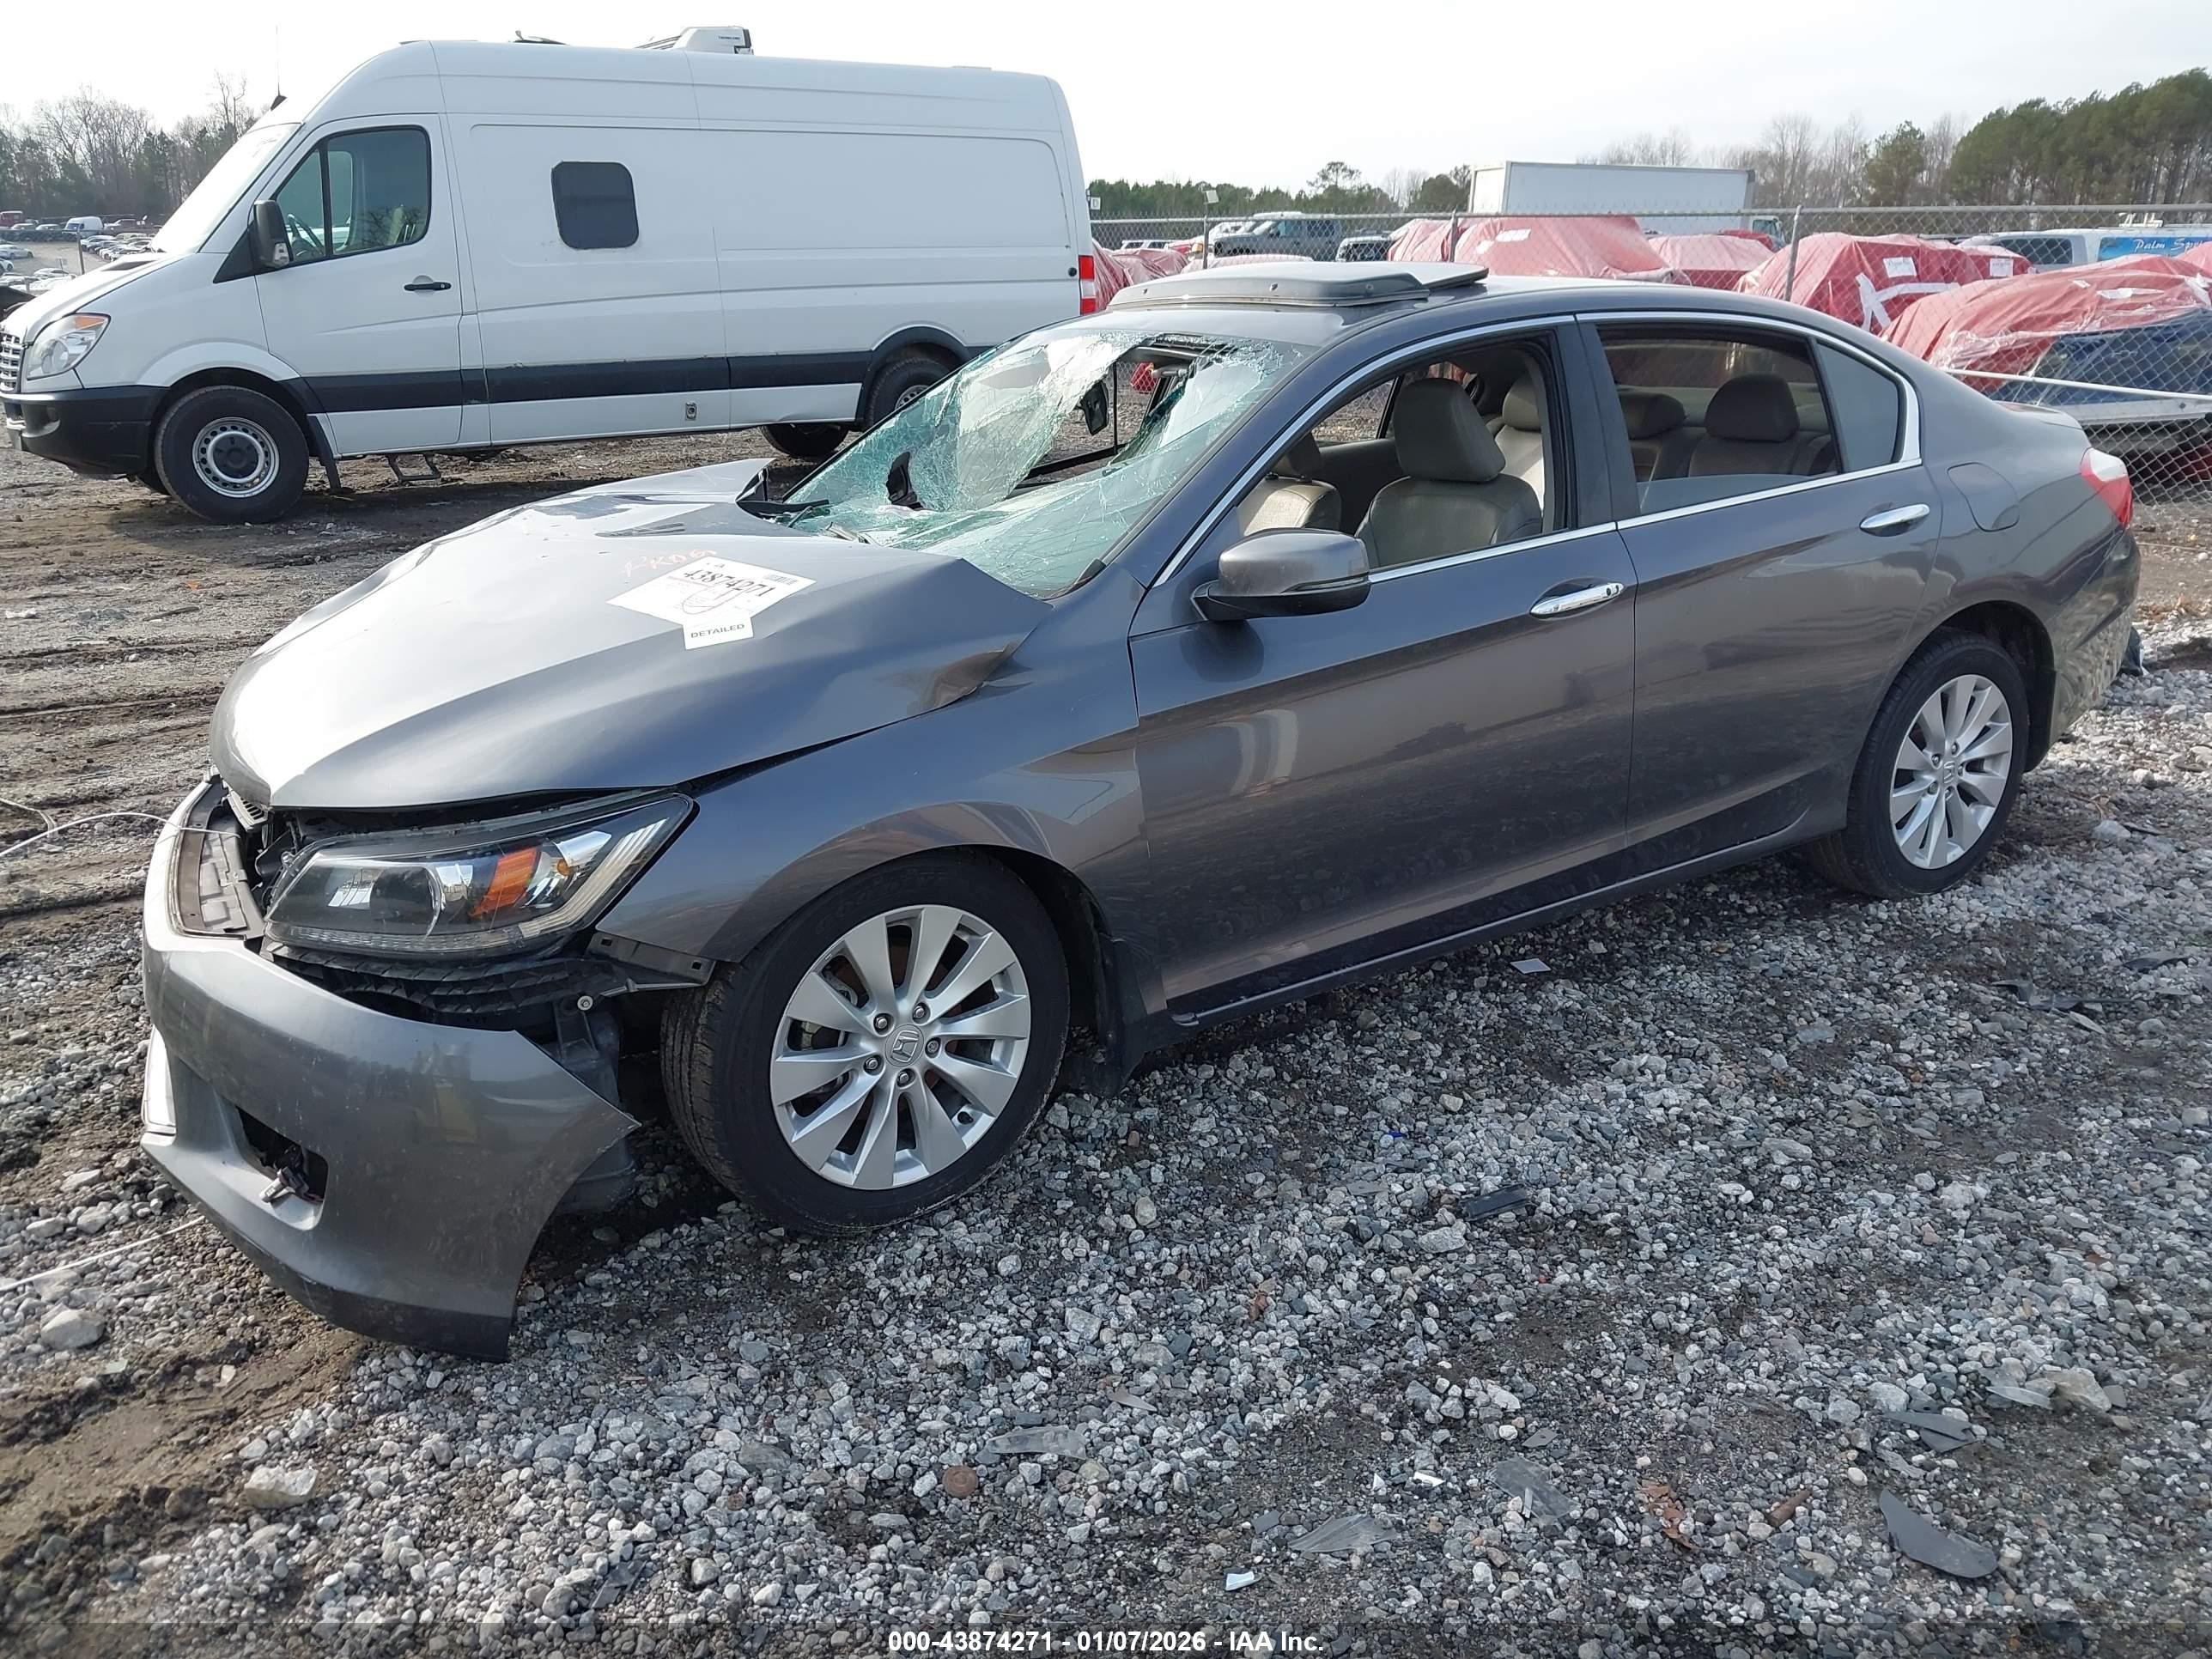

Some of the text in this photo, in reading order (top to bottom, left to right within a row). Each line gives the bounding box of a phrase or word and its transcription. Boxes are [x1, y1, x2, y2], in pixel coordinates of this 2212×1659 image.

[2134, 239, 2166, 252] Palm
[684, 570, 776, 597] 43874271
[690, 623, 745, 639] DETAILED
